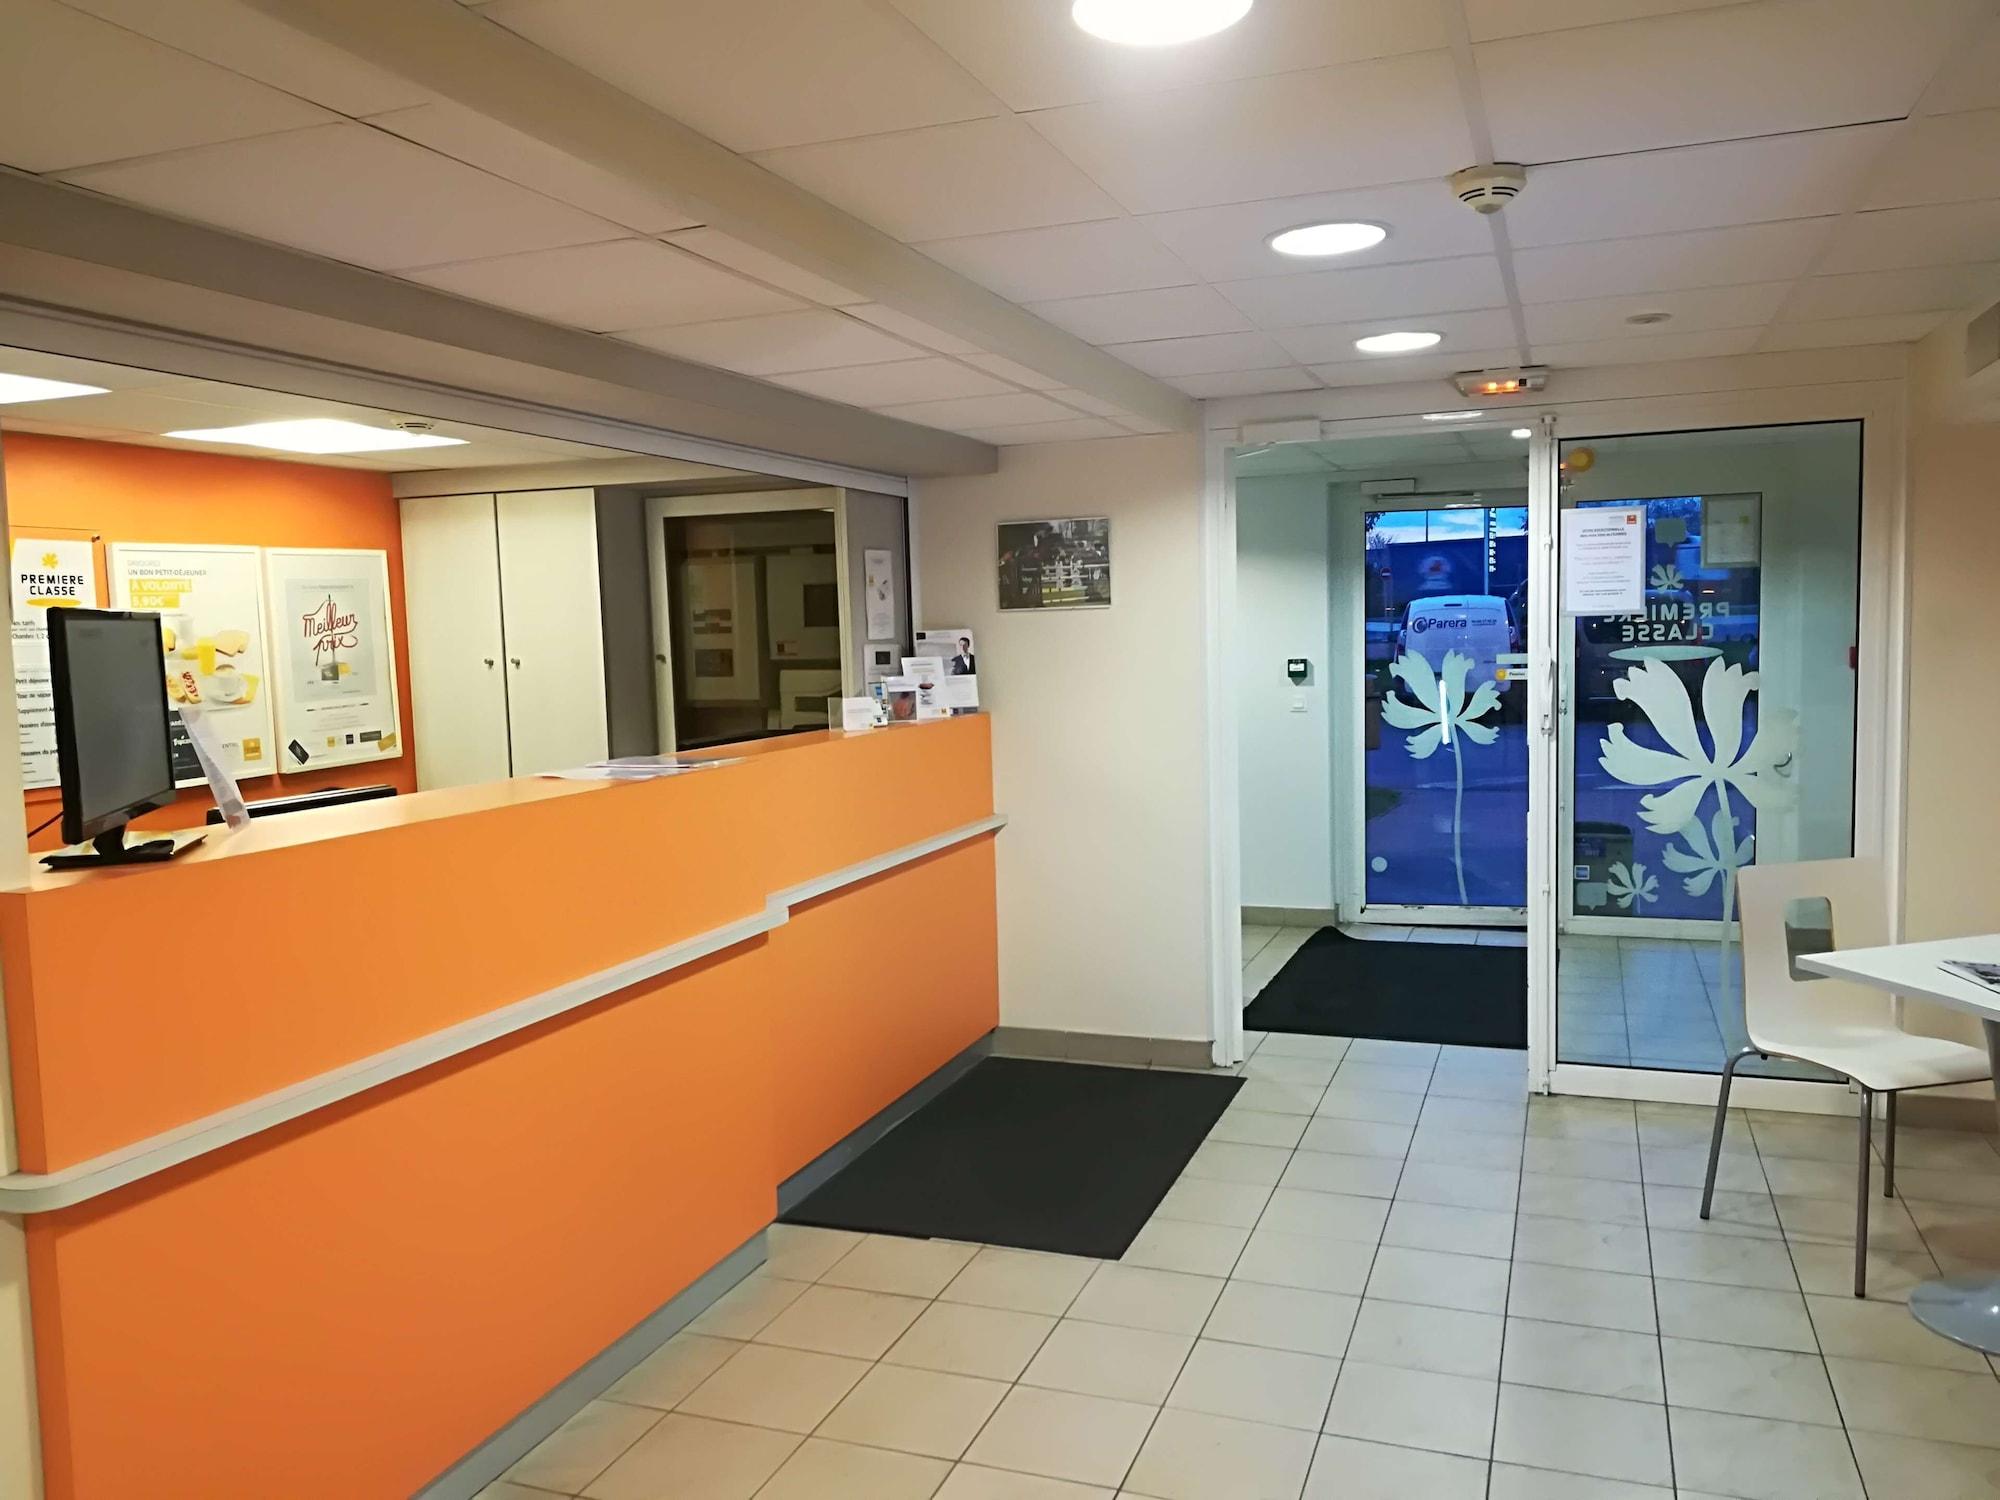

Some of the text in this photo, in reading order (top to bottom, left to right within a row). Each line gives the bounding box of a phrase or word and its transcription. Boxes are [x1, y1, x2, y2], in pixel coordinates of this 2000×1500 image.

[21, 574, 84, 585] PREMIERE
[29, 586, 76, 596] CLASSE
[302, 602, 359, 638] Meilleur
[1428, 618, 1467, 629] Parera
[313, 633, 359, 666] prix
